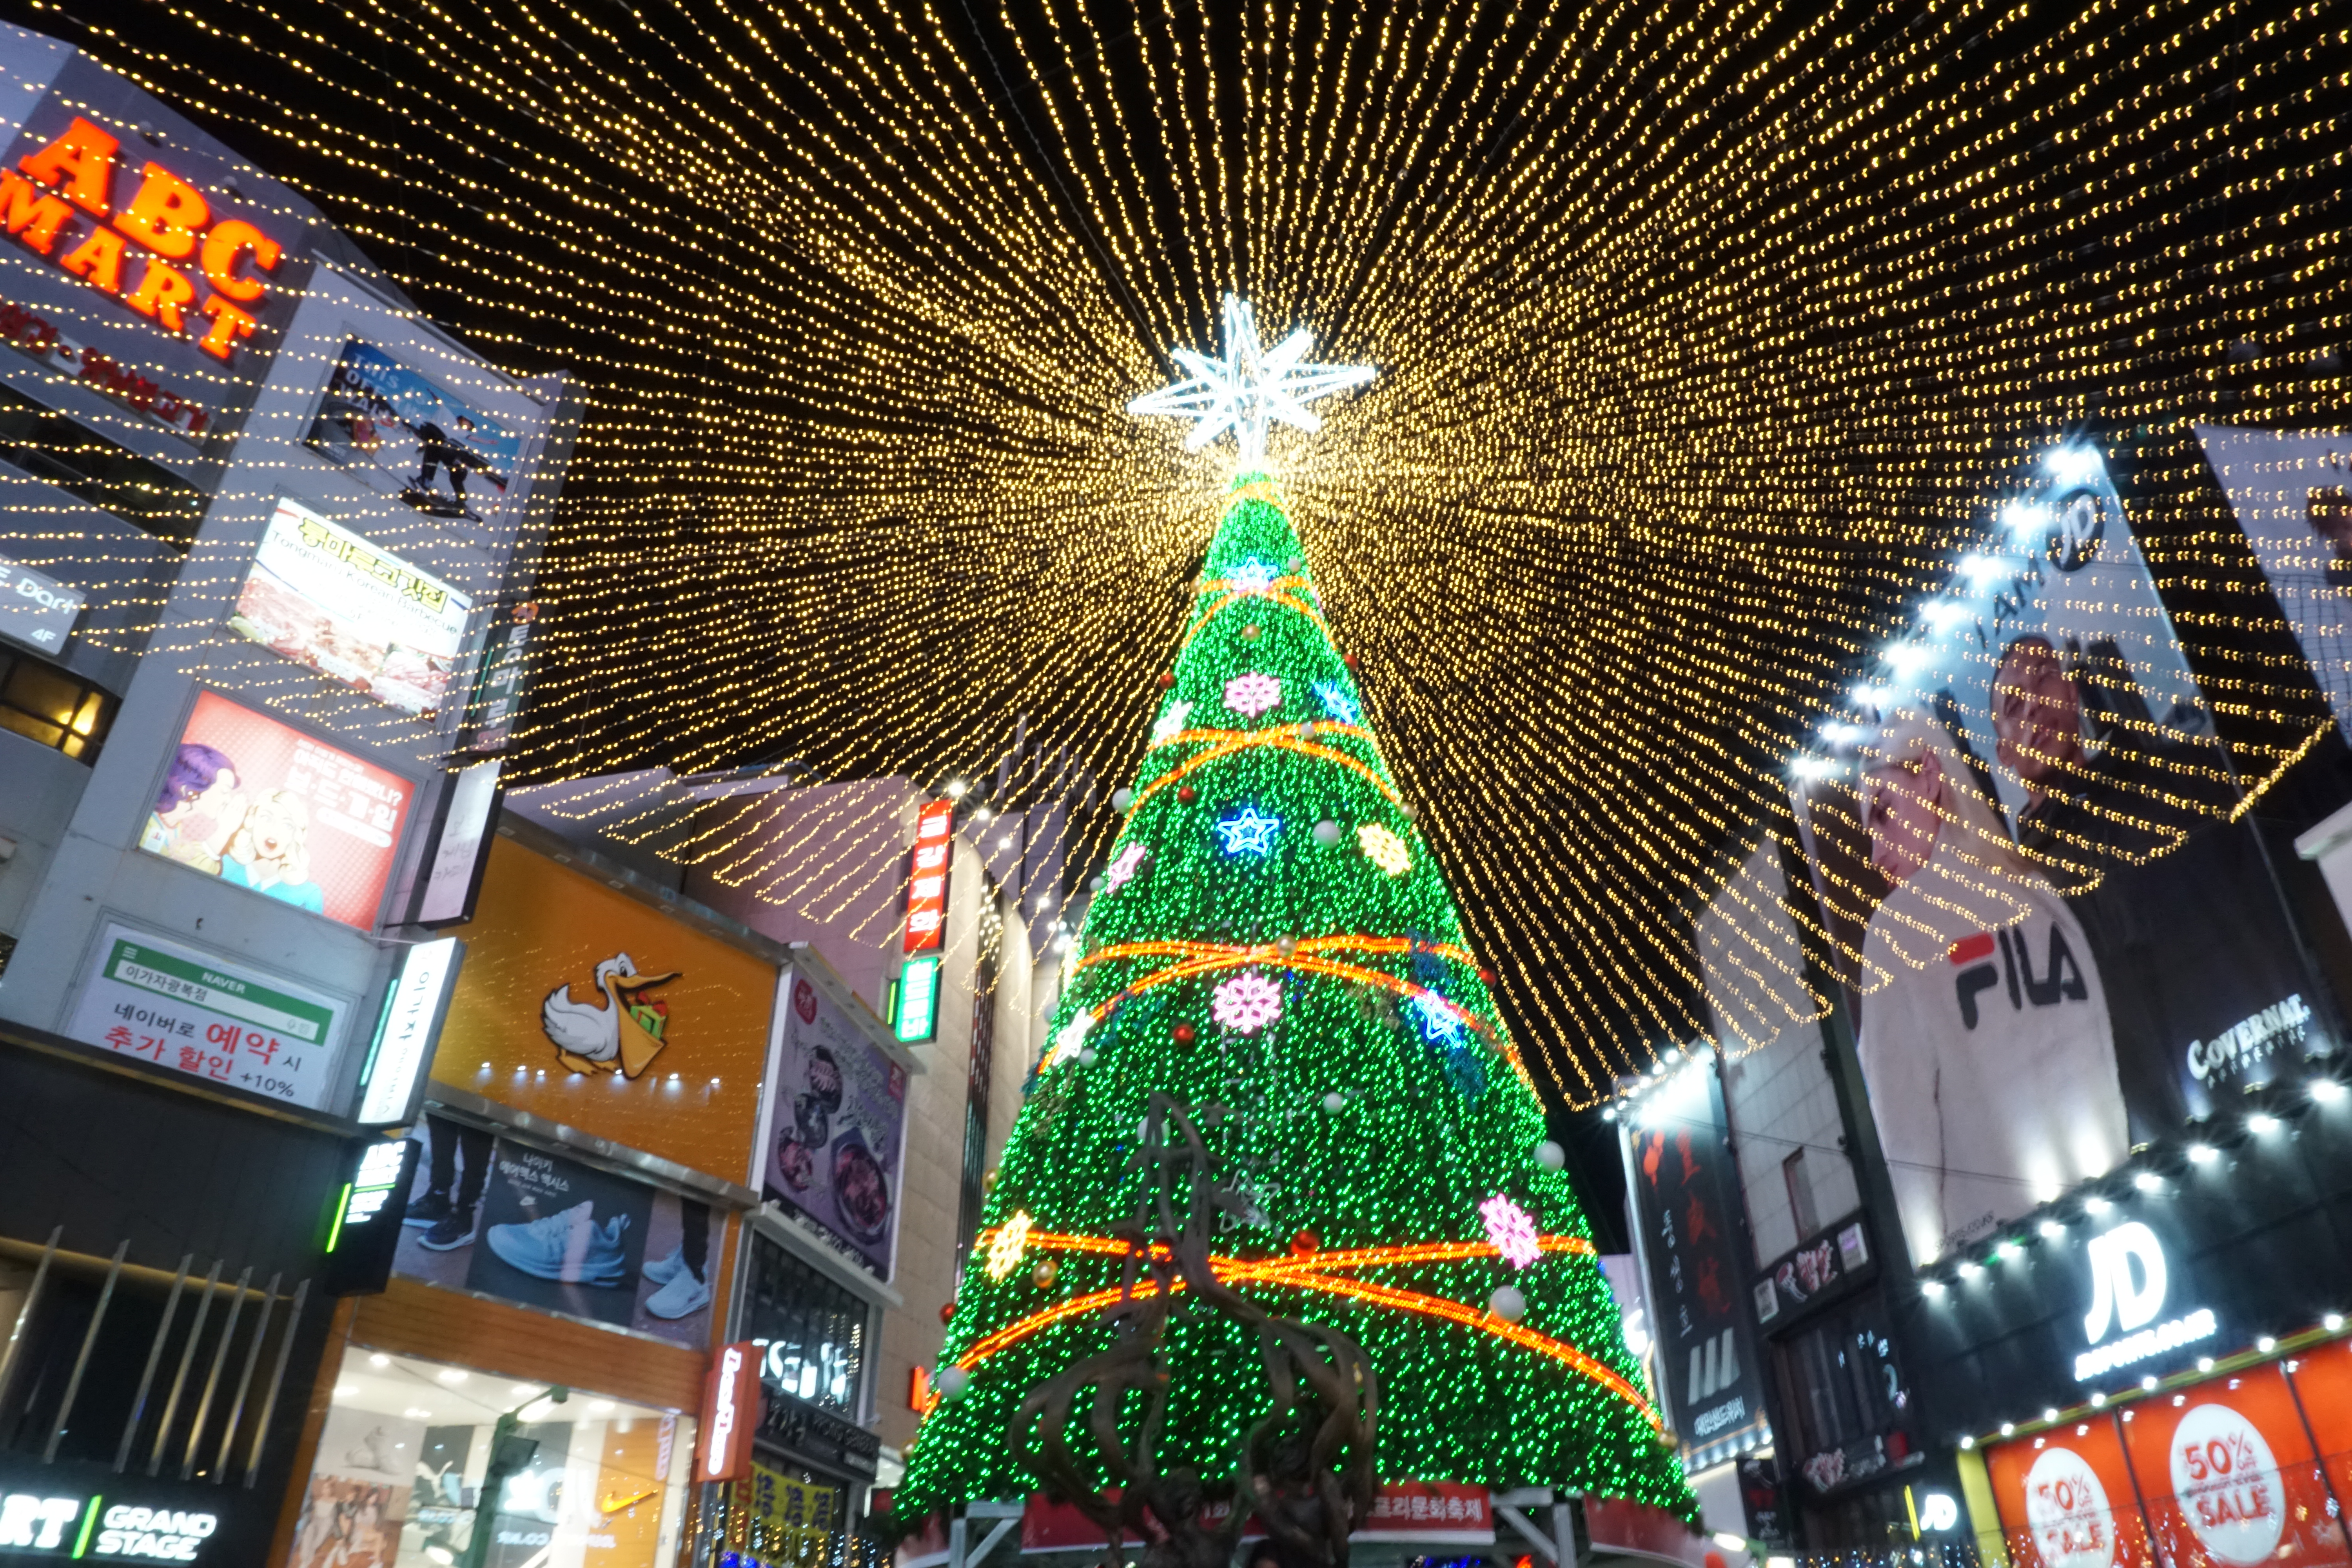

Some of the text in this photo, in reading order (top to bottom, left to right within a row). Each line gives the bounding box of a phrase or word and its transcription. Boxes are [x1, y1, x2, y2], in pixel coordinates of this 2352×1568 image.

[18, 116, 282, 300] ABC
[0, 169, 256, 359] MART
[354, 352, 399, 389] THIS
[2060, 494, 2096, 568] JD
[272, 530, 458, 635] Tongmaru Korean Barbecue
[298, 517, 449, 614] 통마루고깃집
[16, 577, 74, 615] Dart
[31, 628, 56, 642] 4F
[125, 964, 208, 1002] 이가자광복점
[201, 971, 246, 995] NAVER
[1948, 920, 2088, 1031] FILA
[105, 1024, 296, 1098] 추가 할인 +10%
[114, 1002, 301, 1072] 네이버로 예약 시
[2187, 993, 2307, 1080] COVERNAT
[2084, 1222, 2167, 1345] JD
[2183, 1430, 2252, 1480] 50%
[103, 1504, 218, 1538] GRAND
[1920, 1494, 1958, 1531] JD
[2196, 1483, 2275, 1527] SALE
[96, 1530, 201, 1560] STAGE
